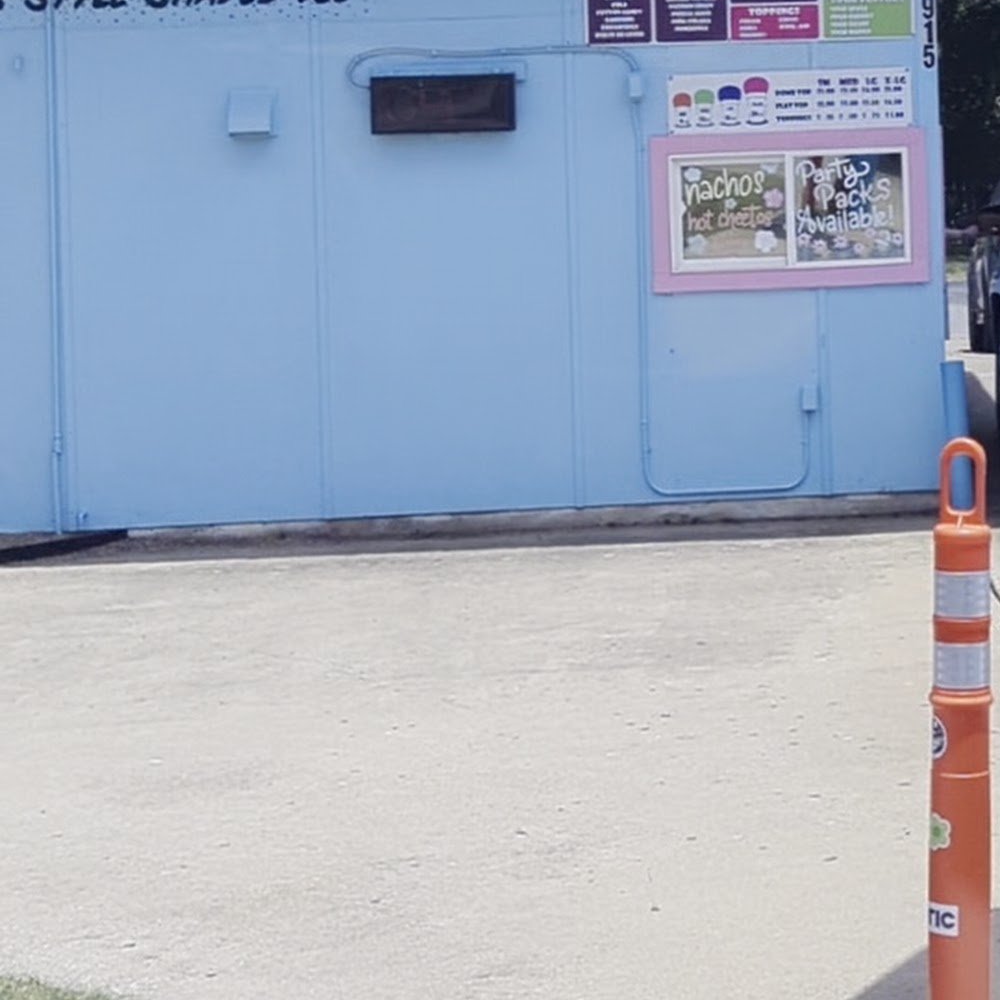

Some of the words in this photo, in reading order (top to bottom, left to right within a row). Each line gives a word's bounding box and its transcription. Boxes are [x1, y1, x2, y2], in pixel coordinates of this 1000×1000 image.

[685, 168, 765, 206] nachos
[796, 157, 871, 188] Party
[813, 178, 891, 210] Packs
[688, 209, 714, 231] hot
[718, 204, 774, 230] cheetos
[797, 204, 895, 234] Available!
